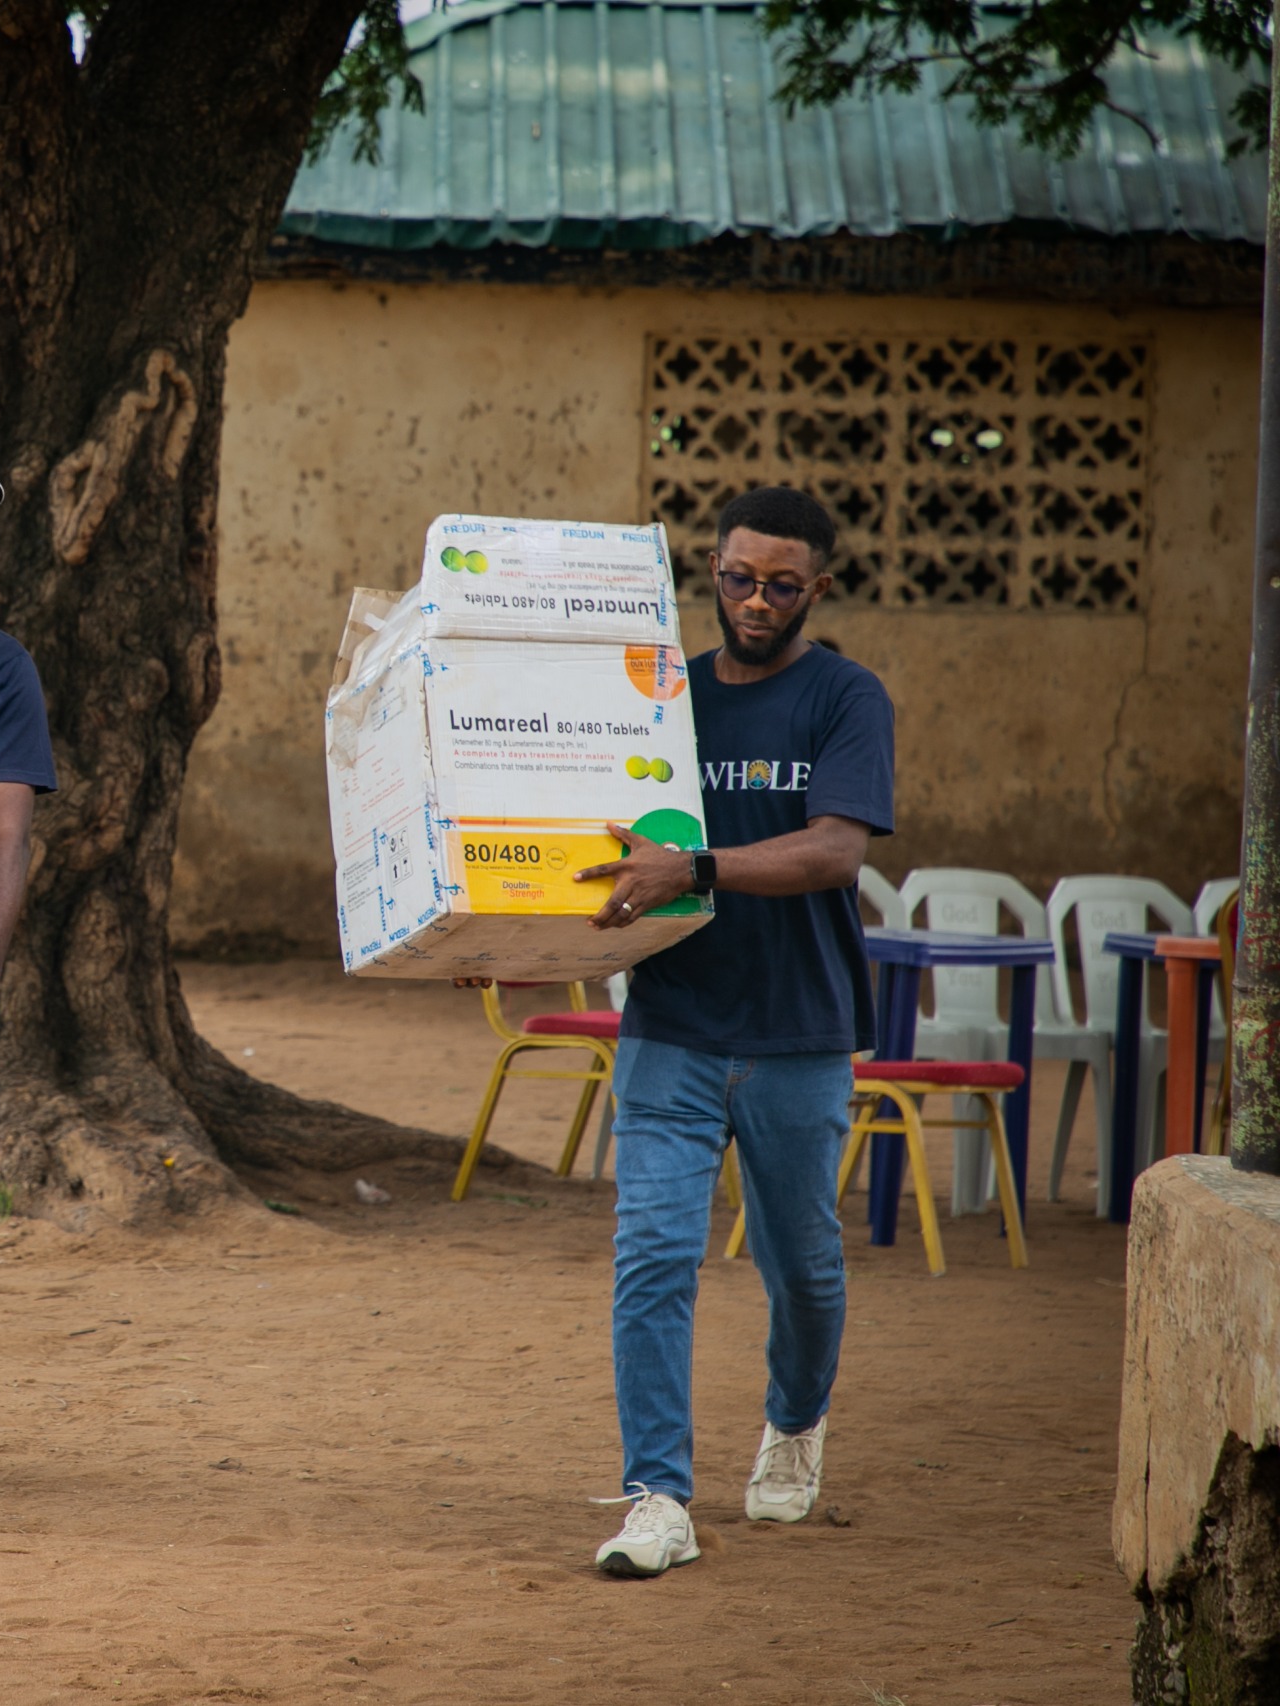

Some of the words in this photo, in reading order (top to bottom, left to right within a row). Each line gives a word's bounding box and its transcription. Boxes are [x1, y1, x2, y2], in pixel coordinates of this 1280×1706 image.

[562, 528, 604, 540] FREDUN
[464, 594, 508, 608] Tablets
[512, 595, 556, 610] 80/480
[564, 598, 660, 622] Lumareal
[450, 709, 548, 733] Lumareal
[557, 720, 602, 737] 80/480
[606, 723, 650, 736] Tablets
[462, 750, 498, 758] complete
[508, 750, 527, 759] days
[571, 752, 582, 760] for
[454, 761, 500, 770] Combinations
[501, 762, 514, 770] that
[515, 763, 534, 771] treats
[545, 765, 578, 773] symptoms
[580, 764, 586, 772] of
[698, 760, 811, 791] WHOLE
[464, 844, 540, 863] 80/480
[502, 881, 530, 889] Double
[509, 889, 544, 900] Strength
[942, 902, 979, 924] God
[1091, 910, 1128, 932] God
